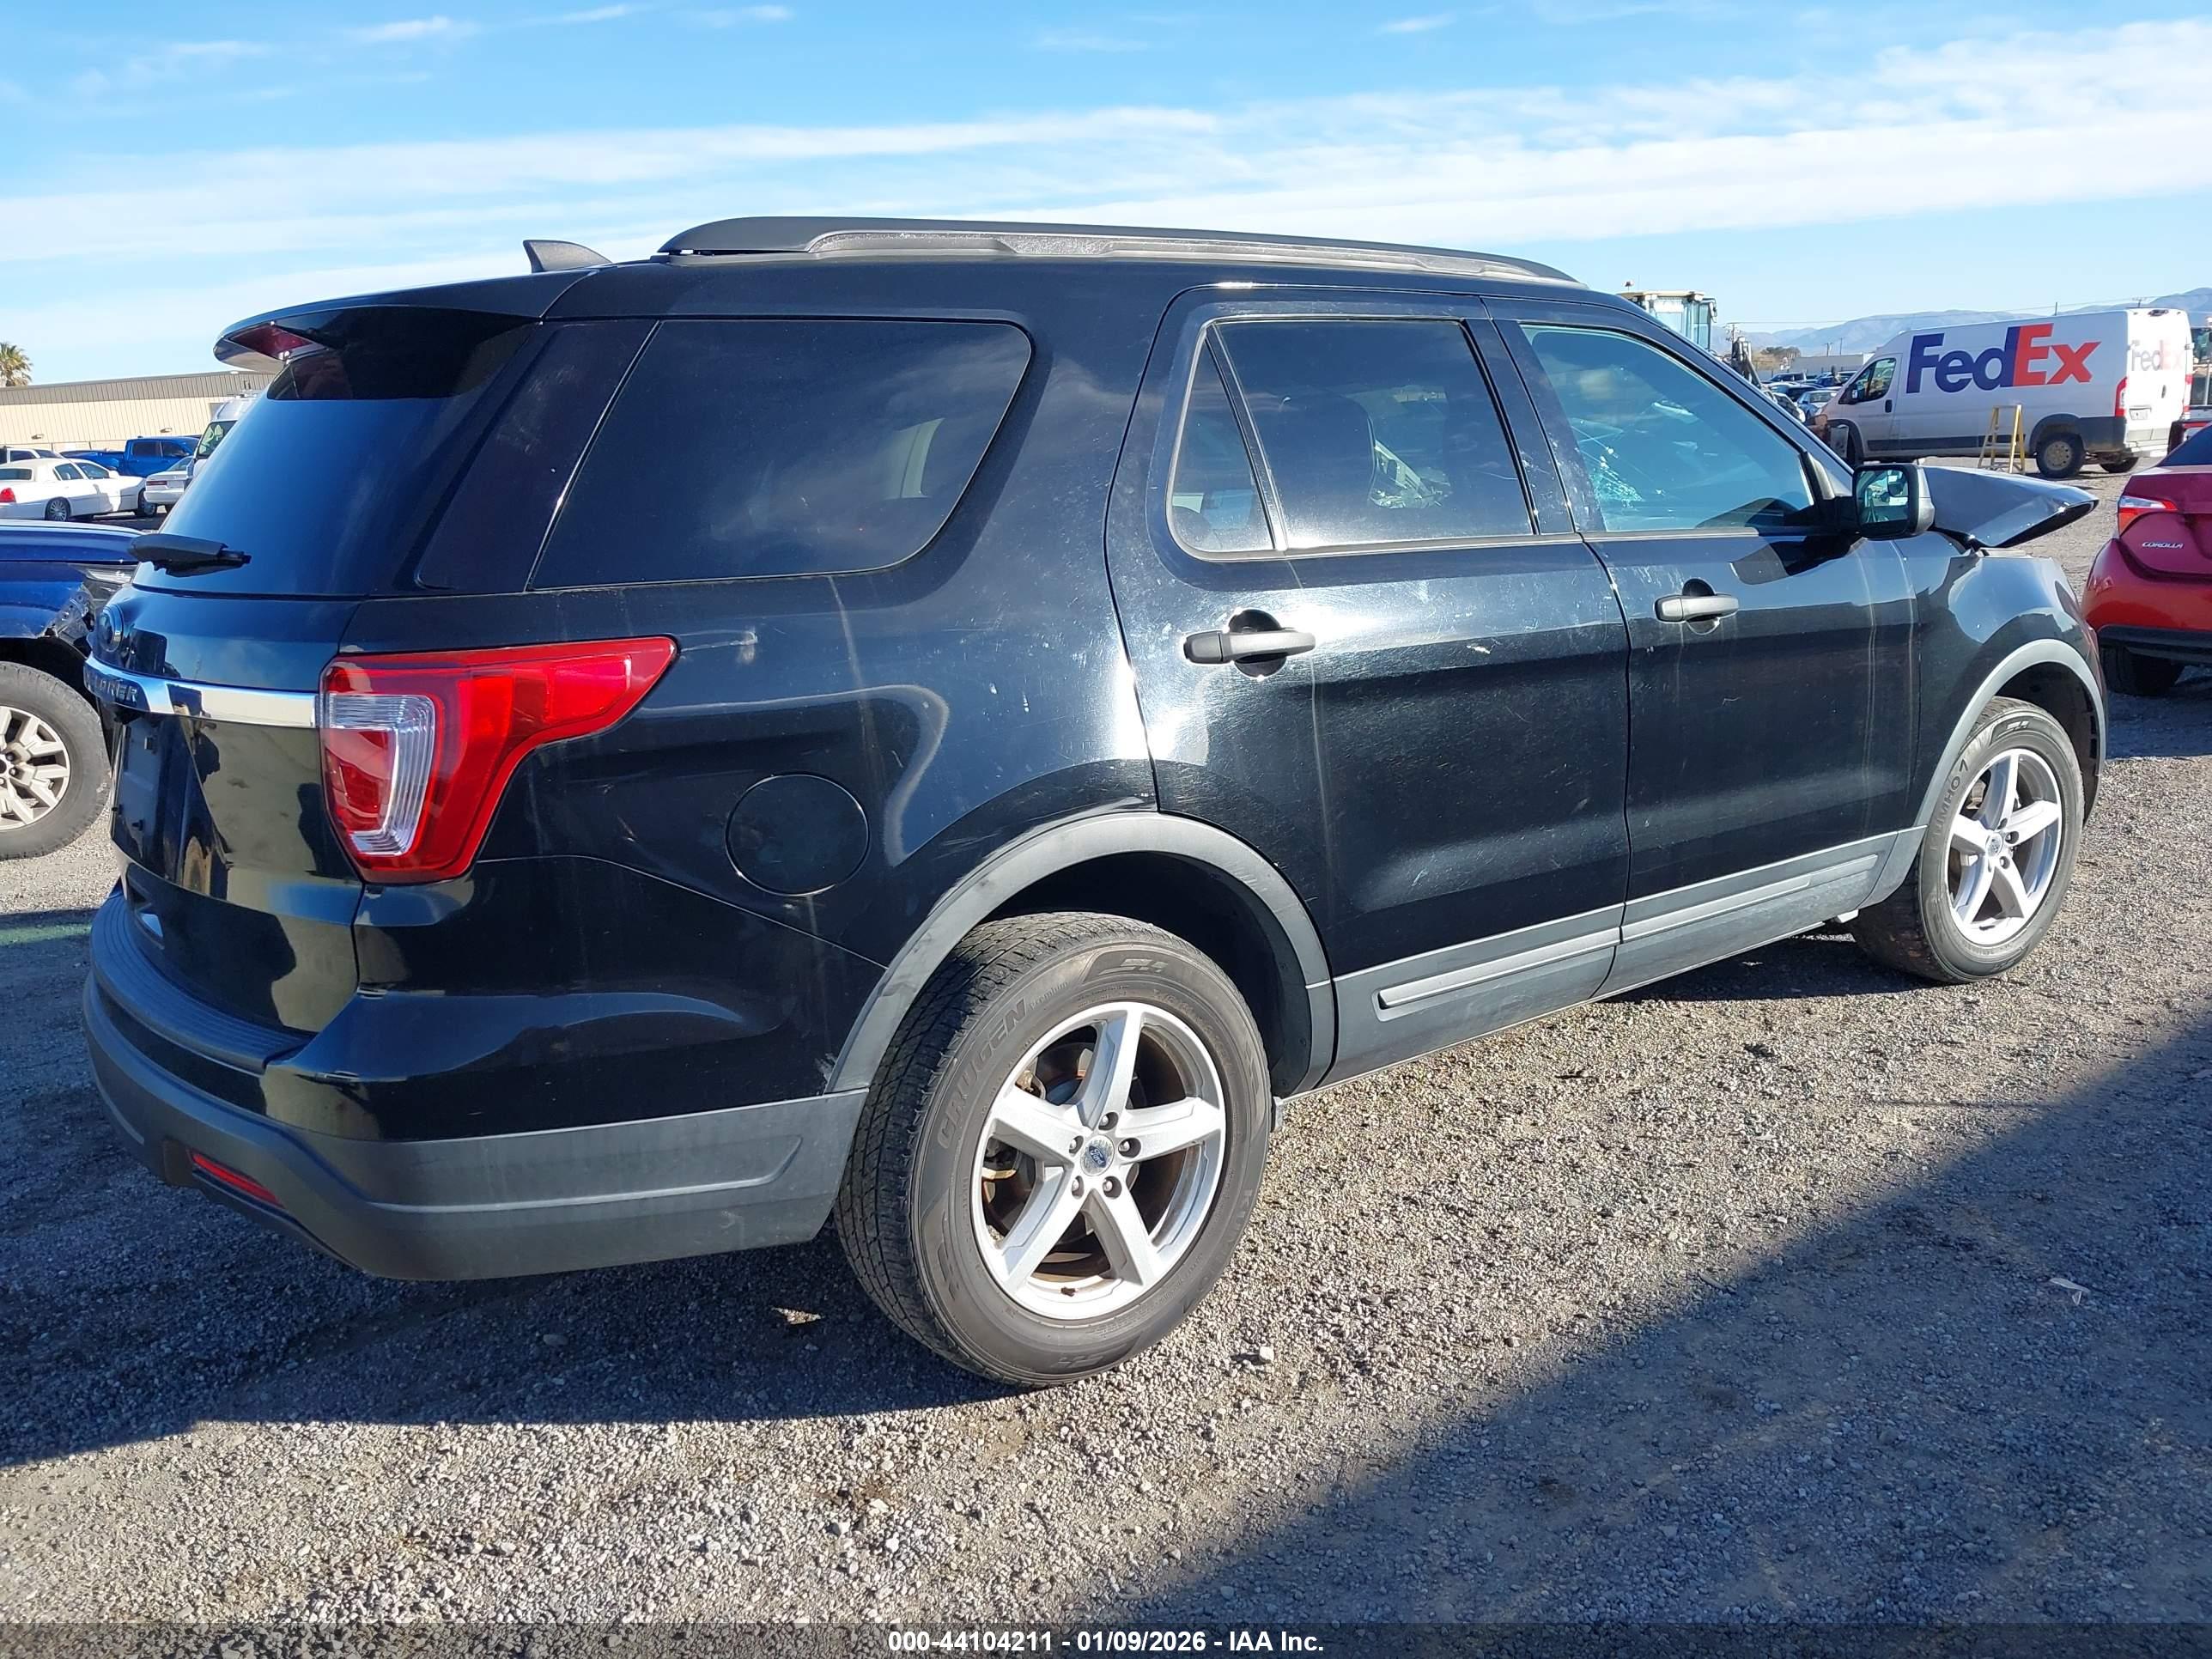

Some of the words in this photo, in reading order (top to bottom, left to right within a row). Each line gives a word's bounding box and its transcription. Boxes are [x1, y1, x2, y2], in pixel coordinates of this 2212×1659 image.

[1906, 323, 2101, 393] FedEx
[2130, 338, 2184, 372] FedEx
[2142, 541, 2184, 550] COROLLA
